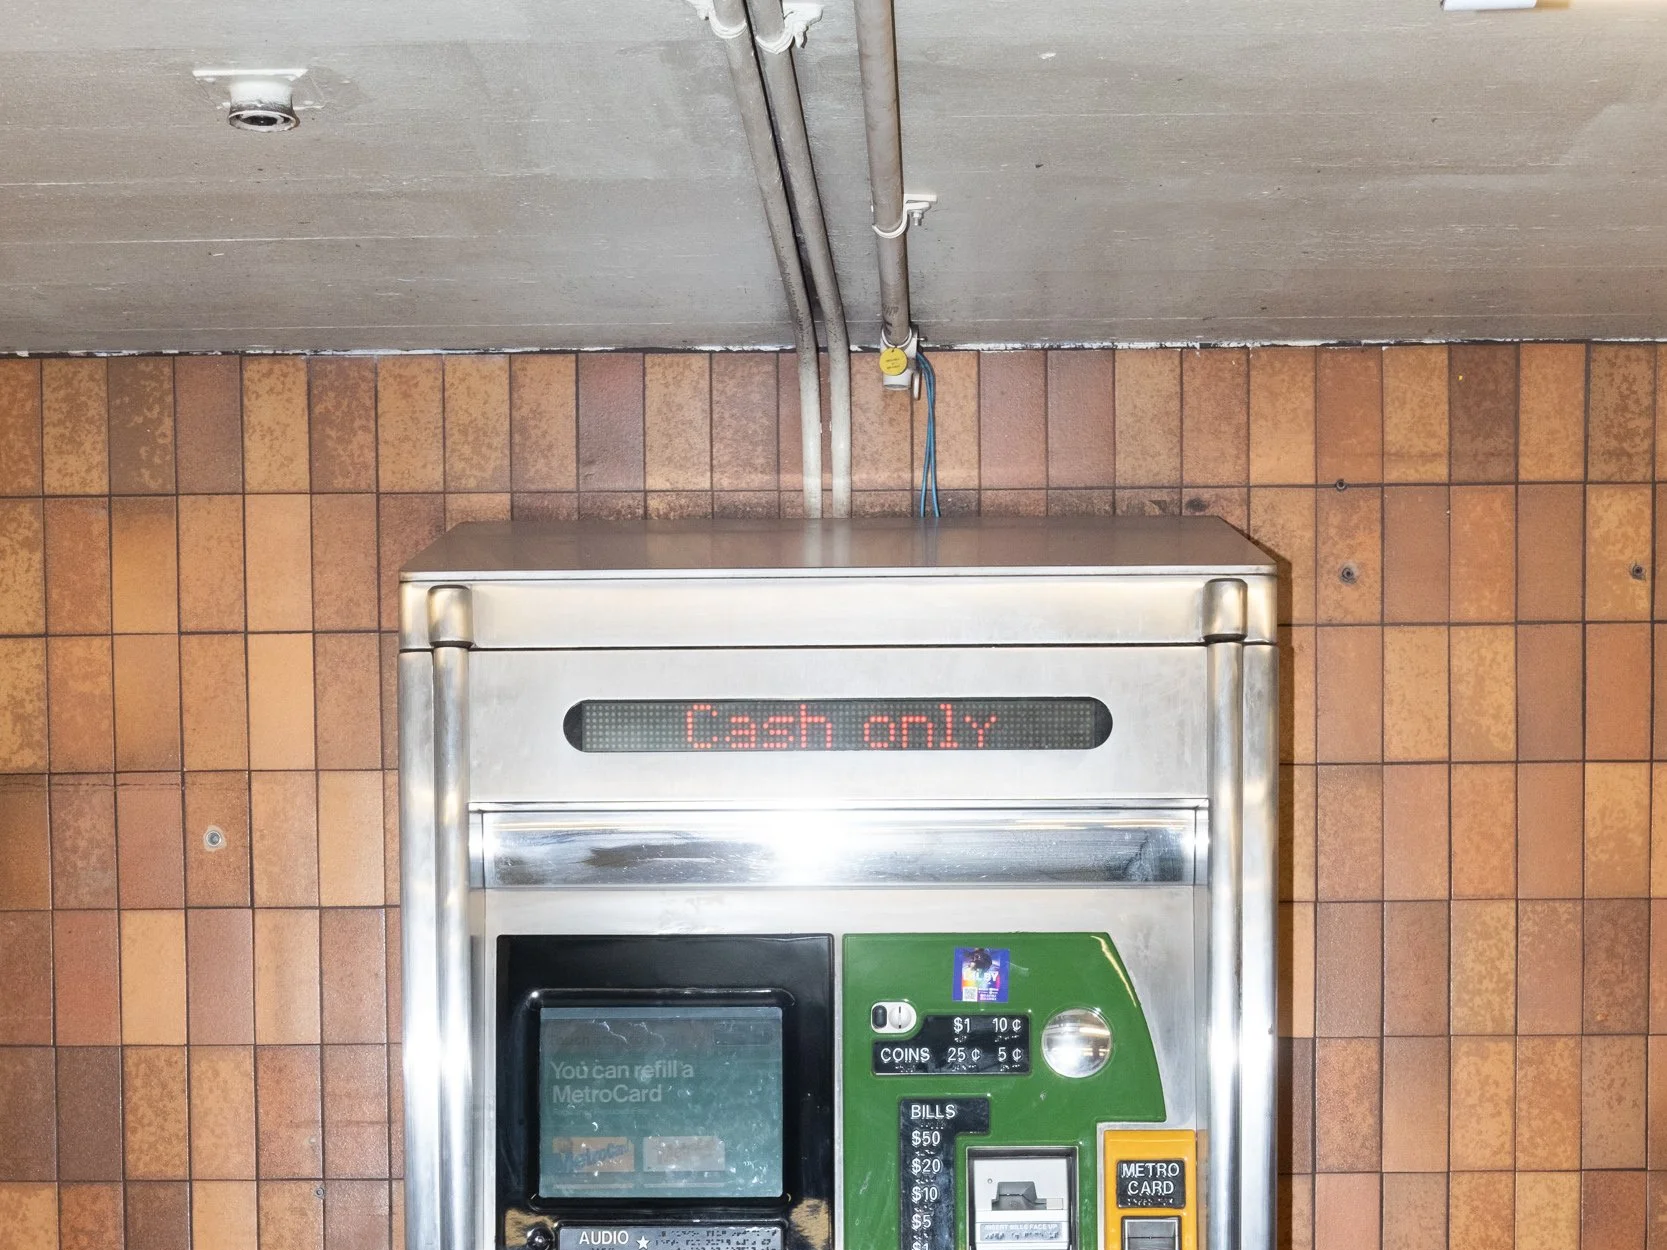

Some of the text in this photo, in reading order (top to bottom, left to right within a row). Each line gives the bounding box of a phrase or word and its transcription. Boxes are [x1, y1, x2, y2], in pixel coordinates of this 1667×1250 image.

[686, 703, 997, 749] Cash only
[953, 1017, 970, 1034] $1
[992, 1017, 1008, 1033] 10
[880, 1048, 931, 1064] COINS
[947, 1048, 966, 1062] 25
[998, 1047, 1007, 1061] 5
[551, 1059, 694, 1079] You can refill a
[552, 1084, 662, 1102] MetroCard
[911, 1104, 956, 1119] BILLS
[911, 1130, 941, 1147] $50
[911, 1158, 941, 1175] $20
[1121, 1163, 1180, 1178] METRO
[911, 1186, 938, 1203] $10
[1128, 1180, 1174, 1196] CARD
[911, 1213, 932, 1230] $5
[579, 1231, 629, 1245] AUDIO
